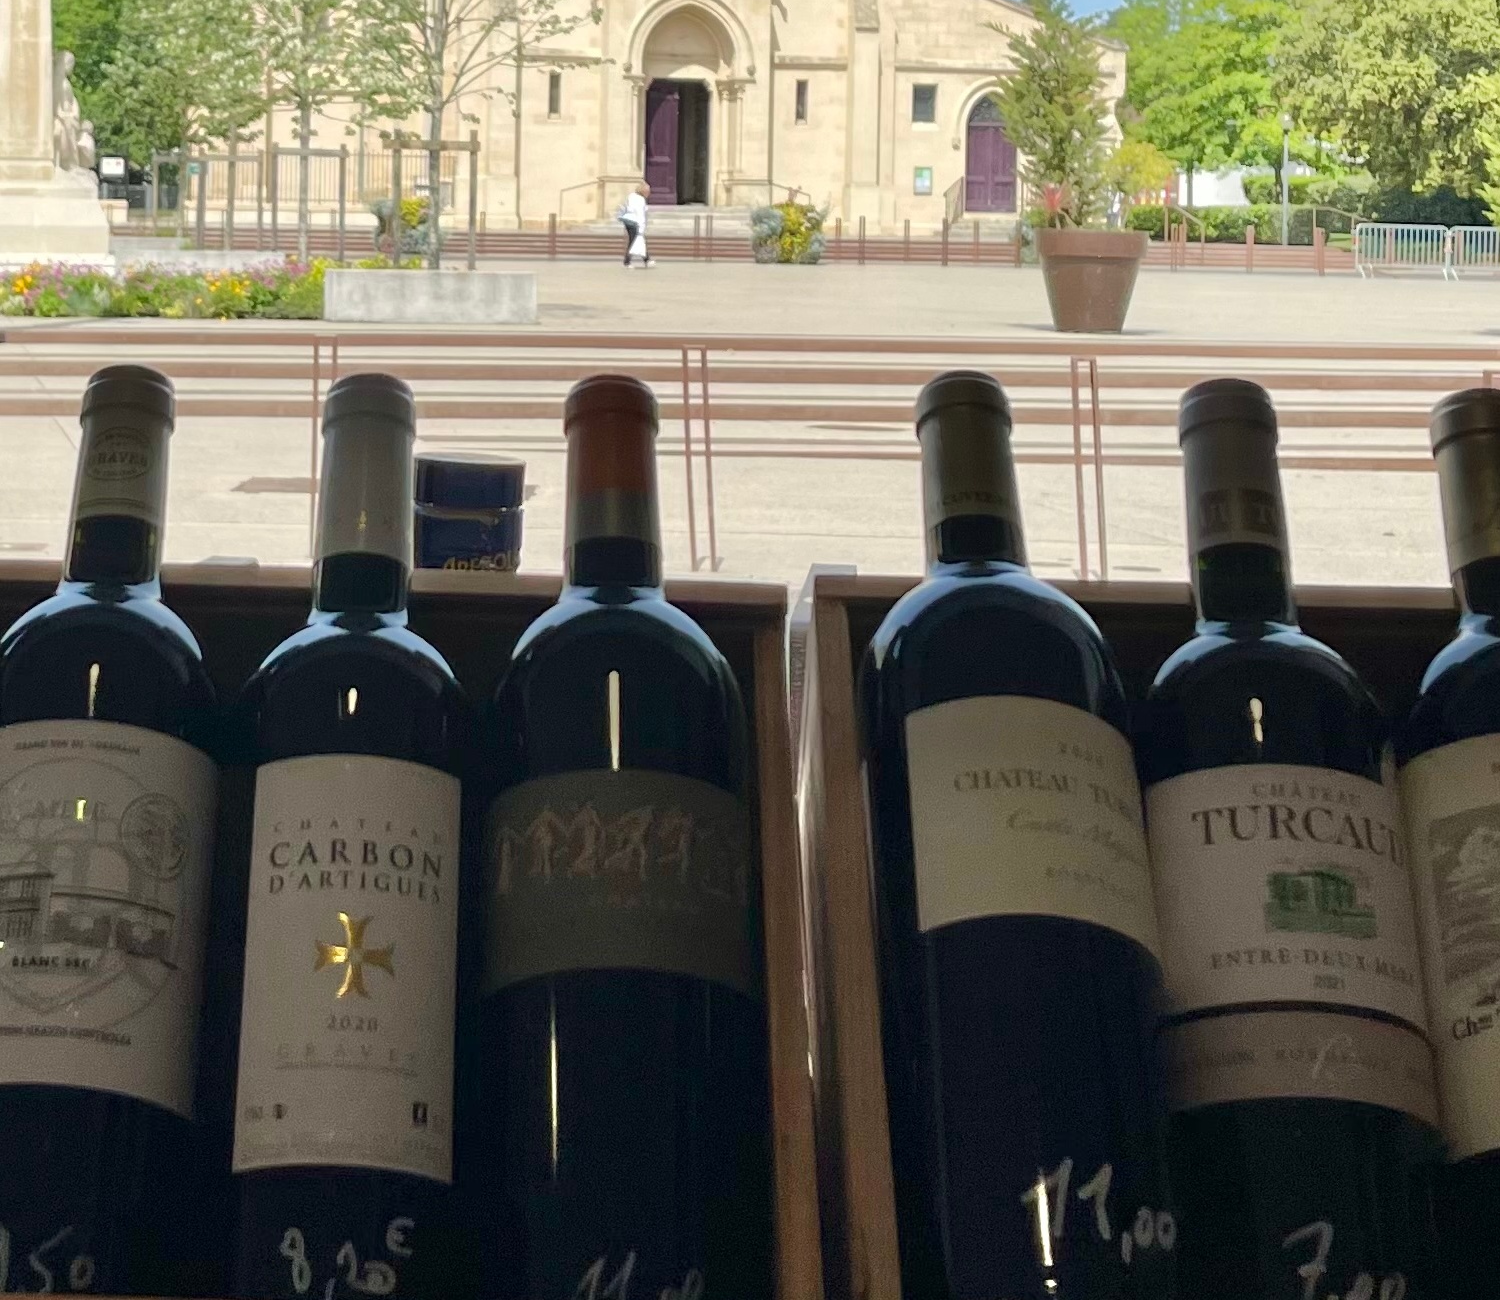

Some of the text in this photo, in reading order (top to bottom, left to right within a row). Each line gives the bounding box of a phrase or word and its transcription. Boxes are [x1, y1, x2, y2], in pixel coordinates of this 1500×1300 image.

[952, 767, 1079, 796] CHATEAU
[268, 837, 443, 880] CARBON
[267, 869, 442, 905] D'ARTIGUES
[327, 1013, 379, 1033] 2020
